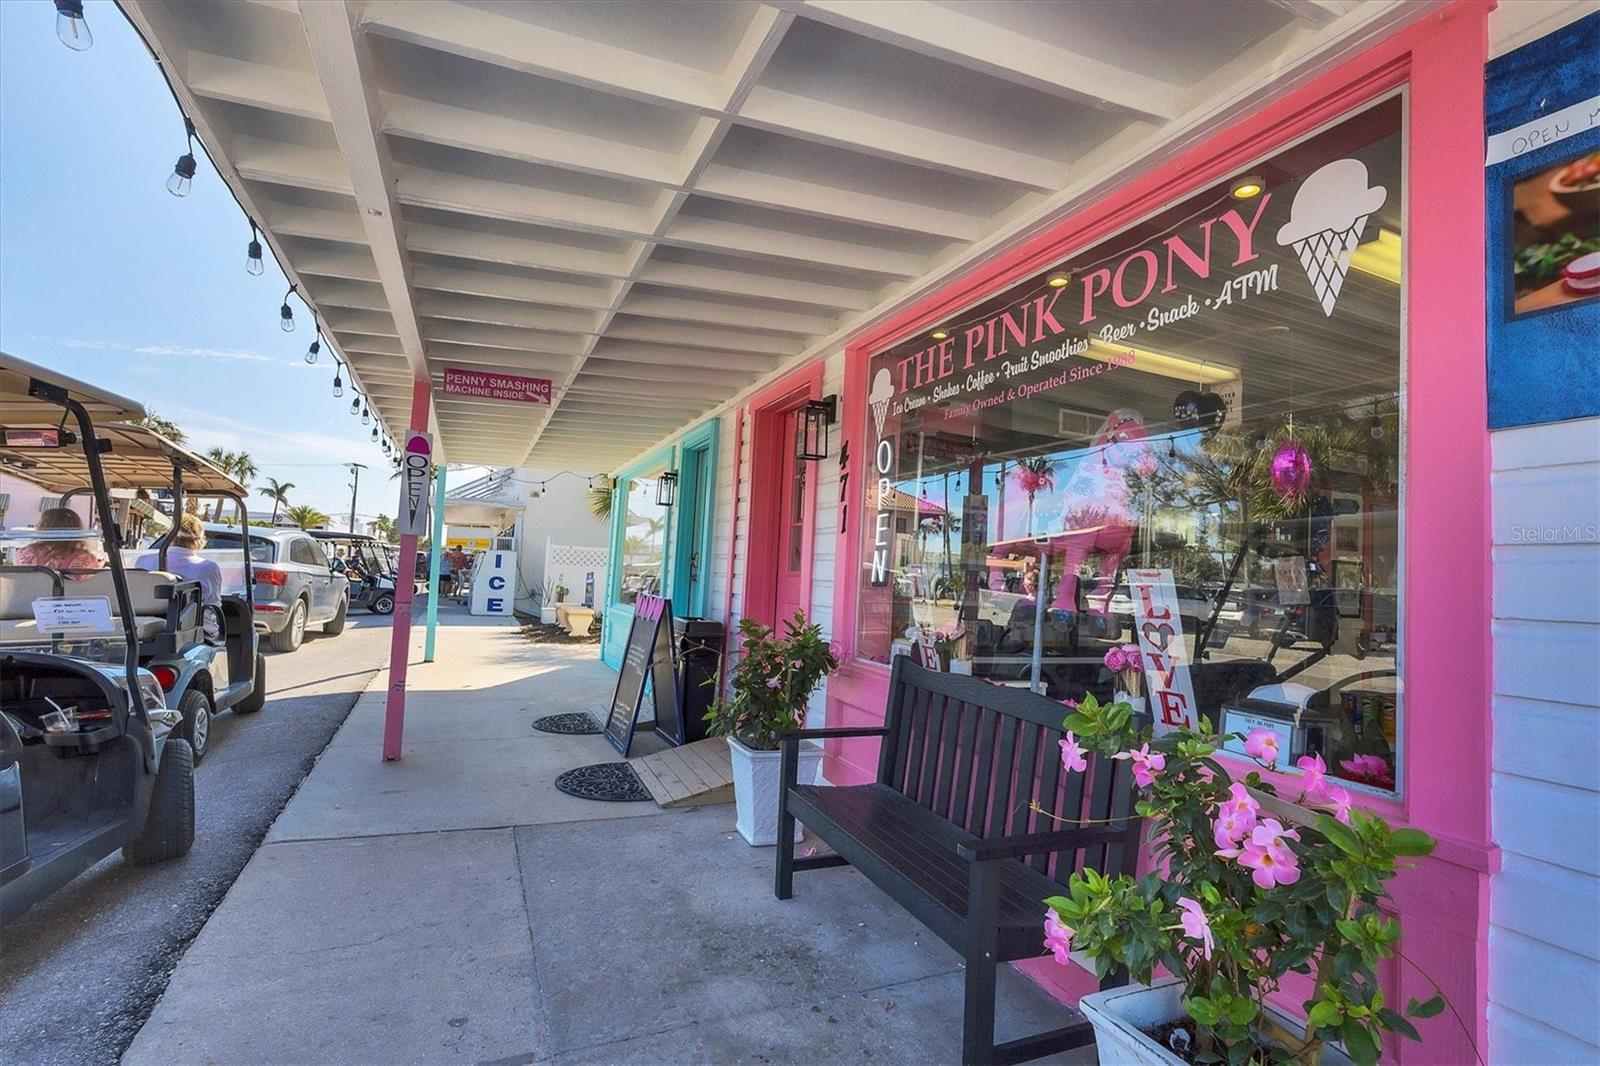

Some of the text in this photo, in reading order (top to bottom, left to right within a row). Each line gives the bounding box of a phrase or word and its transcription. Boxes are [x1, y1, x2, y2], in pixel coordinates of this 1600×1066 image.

[1511, 120, 1569, 154] OPEN
[897, 193, 1271, 393] THE PINK PONY
[892, 264, 1279, 416] Ice Cream Shakes Coffee Fruit Smoothies Beer Snack ATM
[446, 374, 549, 393] PENNY SMASHING
[446, 384, 525, 400] MACHINE INSIDE
[944, 350, 1136, 419] Family Owned & Operated Since 1988
[406, 454, 428, 511] OPEN
[871, 440, 891, 583] OPEN
[486, 554, 505, 612] ICE
